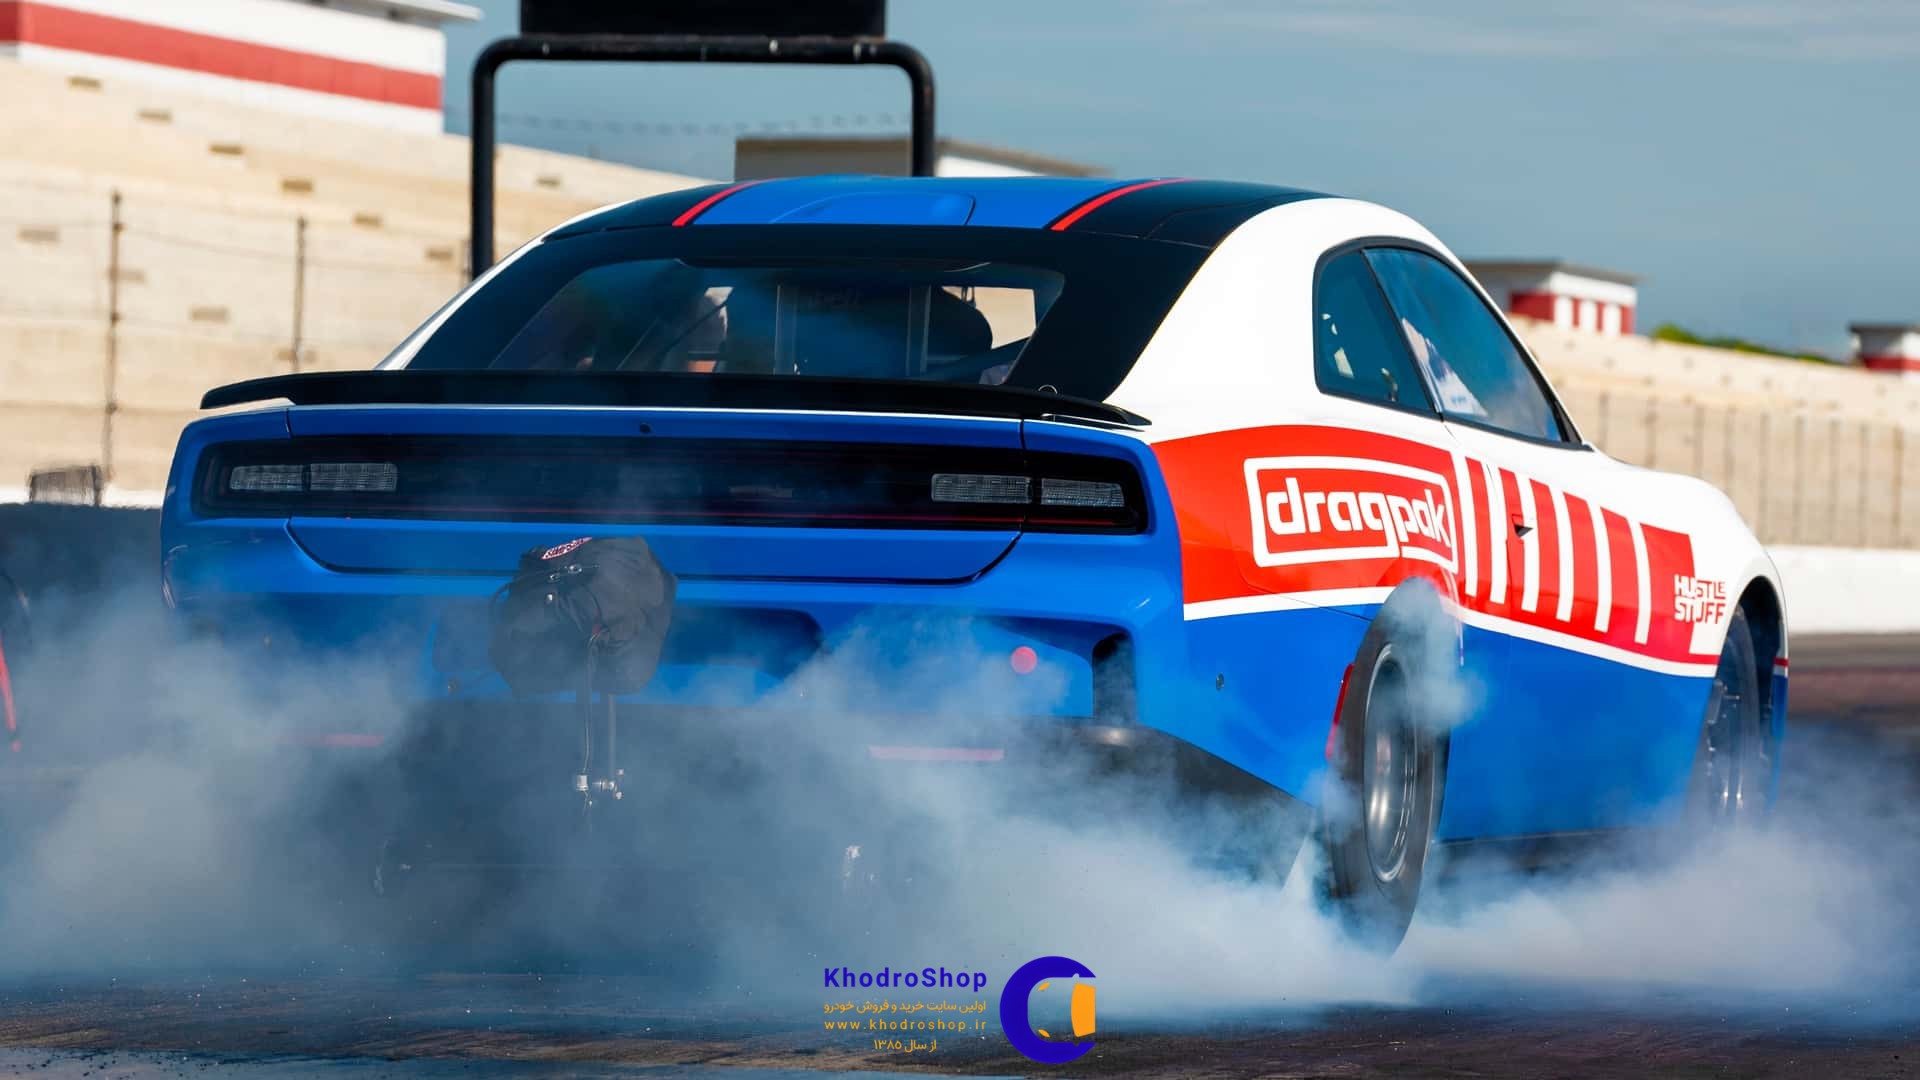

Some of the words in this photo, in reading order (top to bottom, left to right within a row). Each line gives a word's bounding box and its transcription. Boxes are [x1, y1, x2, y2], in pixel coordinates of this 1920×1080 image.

[1266, 477, 1452, 554] dragpak
[1673, 573, 1726, 600] HUSTLE
[1674, 599, 1726, 624] STUFF
